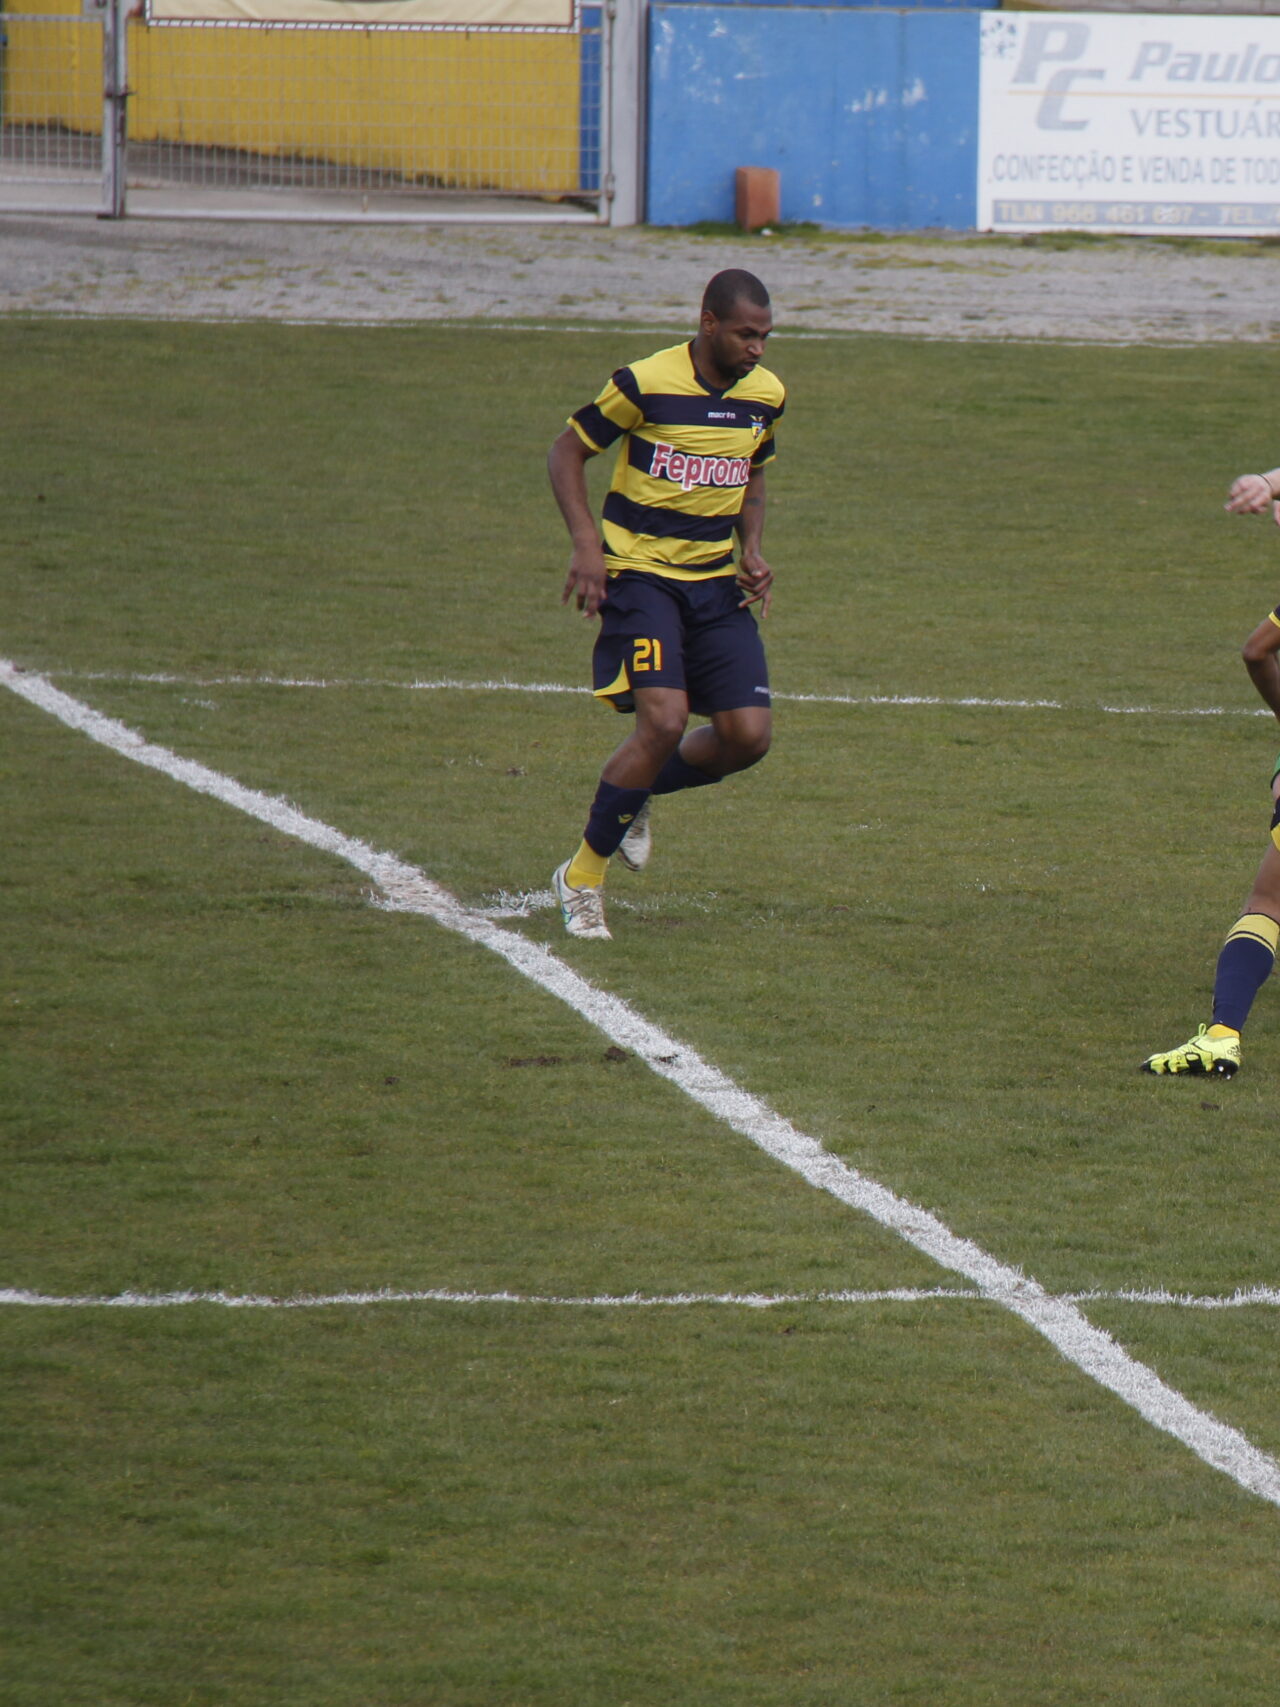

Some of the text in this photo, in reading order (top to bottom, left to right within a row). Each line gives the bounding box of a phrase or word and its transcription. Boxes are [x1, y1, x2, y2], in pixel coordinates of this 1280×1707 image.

[992, 150, 1116, 190] CONFECÇÃO
[1121, 155, 1134, 183] E
[1139, 155, 1204, 184] VENDA
[1210, 157, 1236, 184] DE
[649, 441, 751, 491] Feprono
[633, 638, 662, 672] 21
